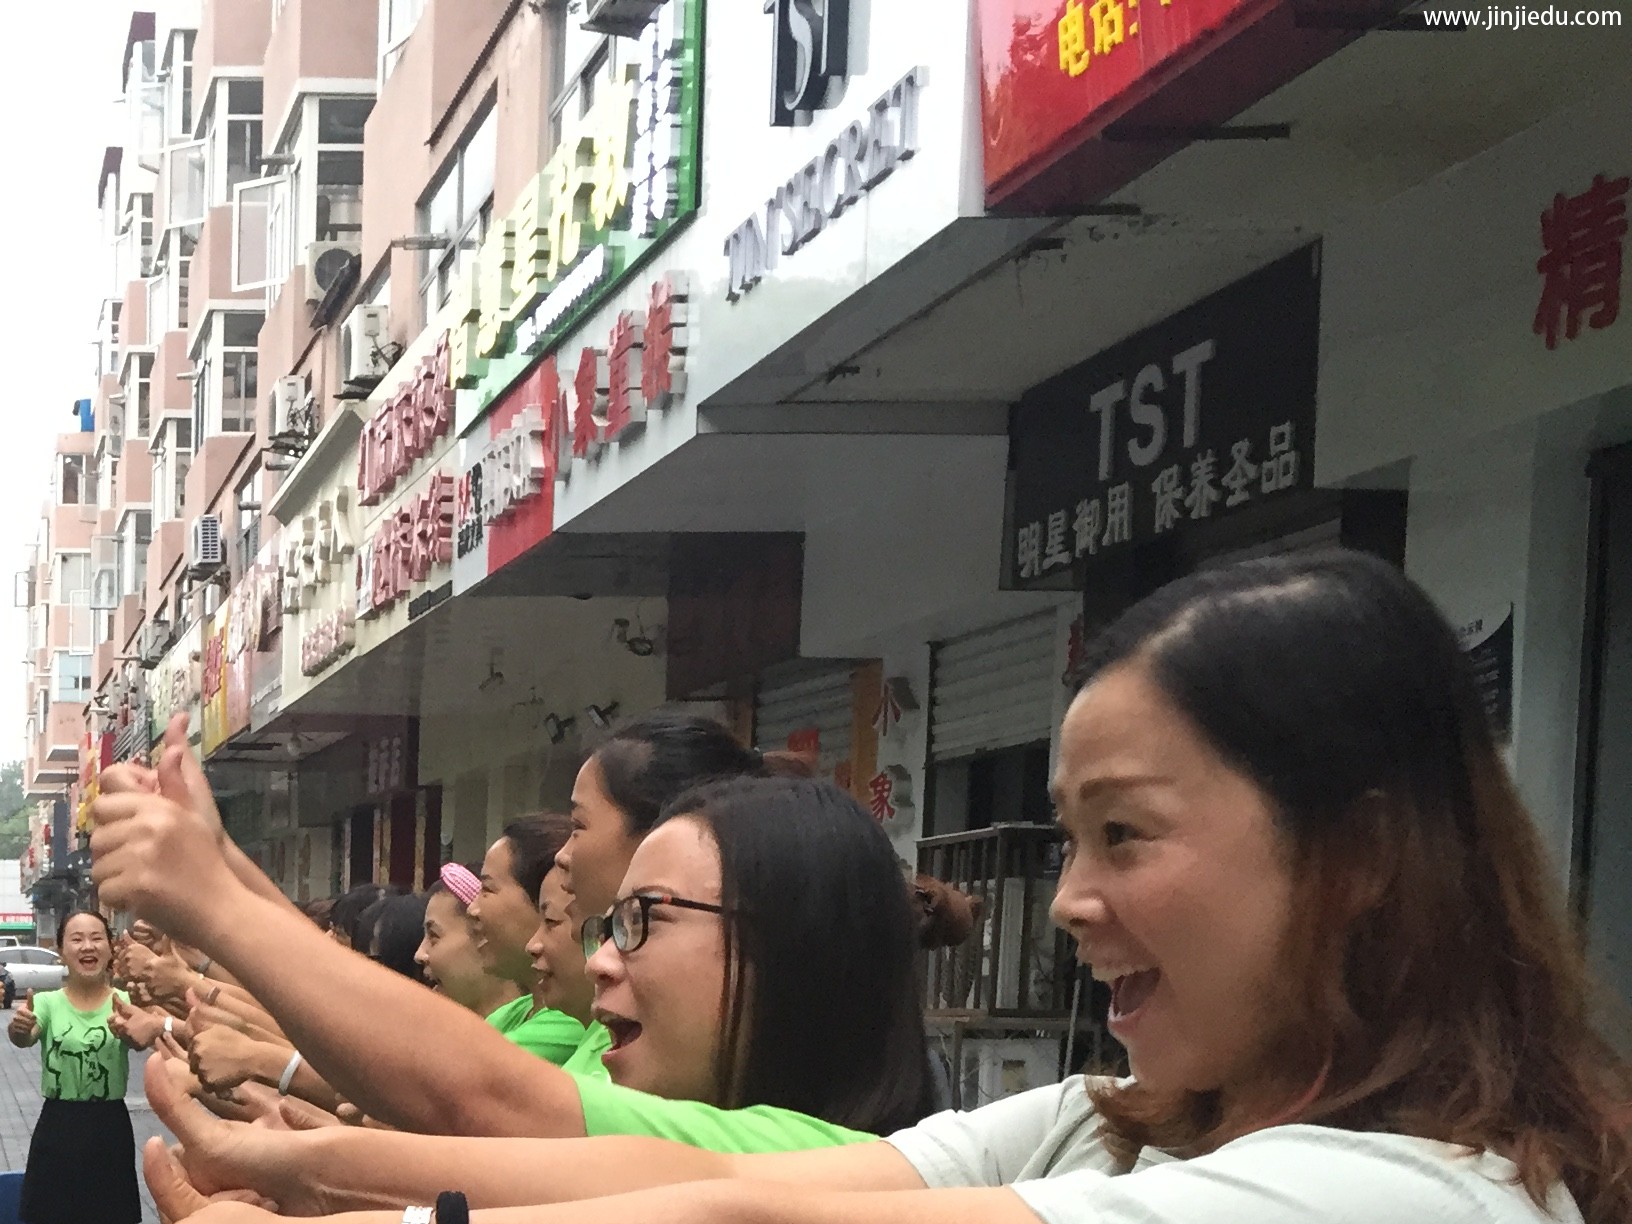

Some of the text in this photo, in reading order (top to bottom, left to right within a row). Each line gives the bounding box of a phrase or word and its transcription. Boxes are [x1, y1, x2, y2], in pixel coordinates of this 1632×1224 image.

[1532, 173, 1632, 351] 精
[1089, 339, 1216, 481] TST
[1016, 421, 1298, 578] 明星御用 保养圣品
